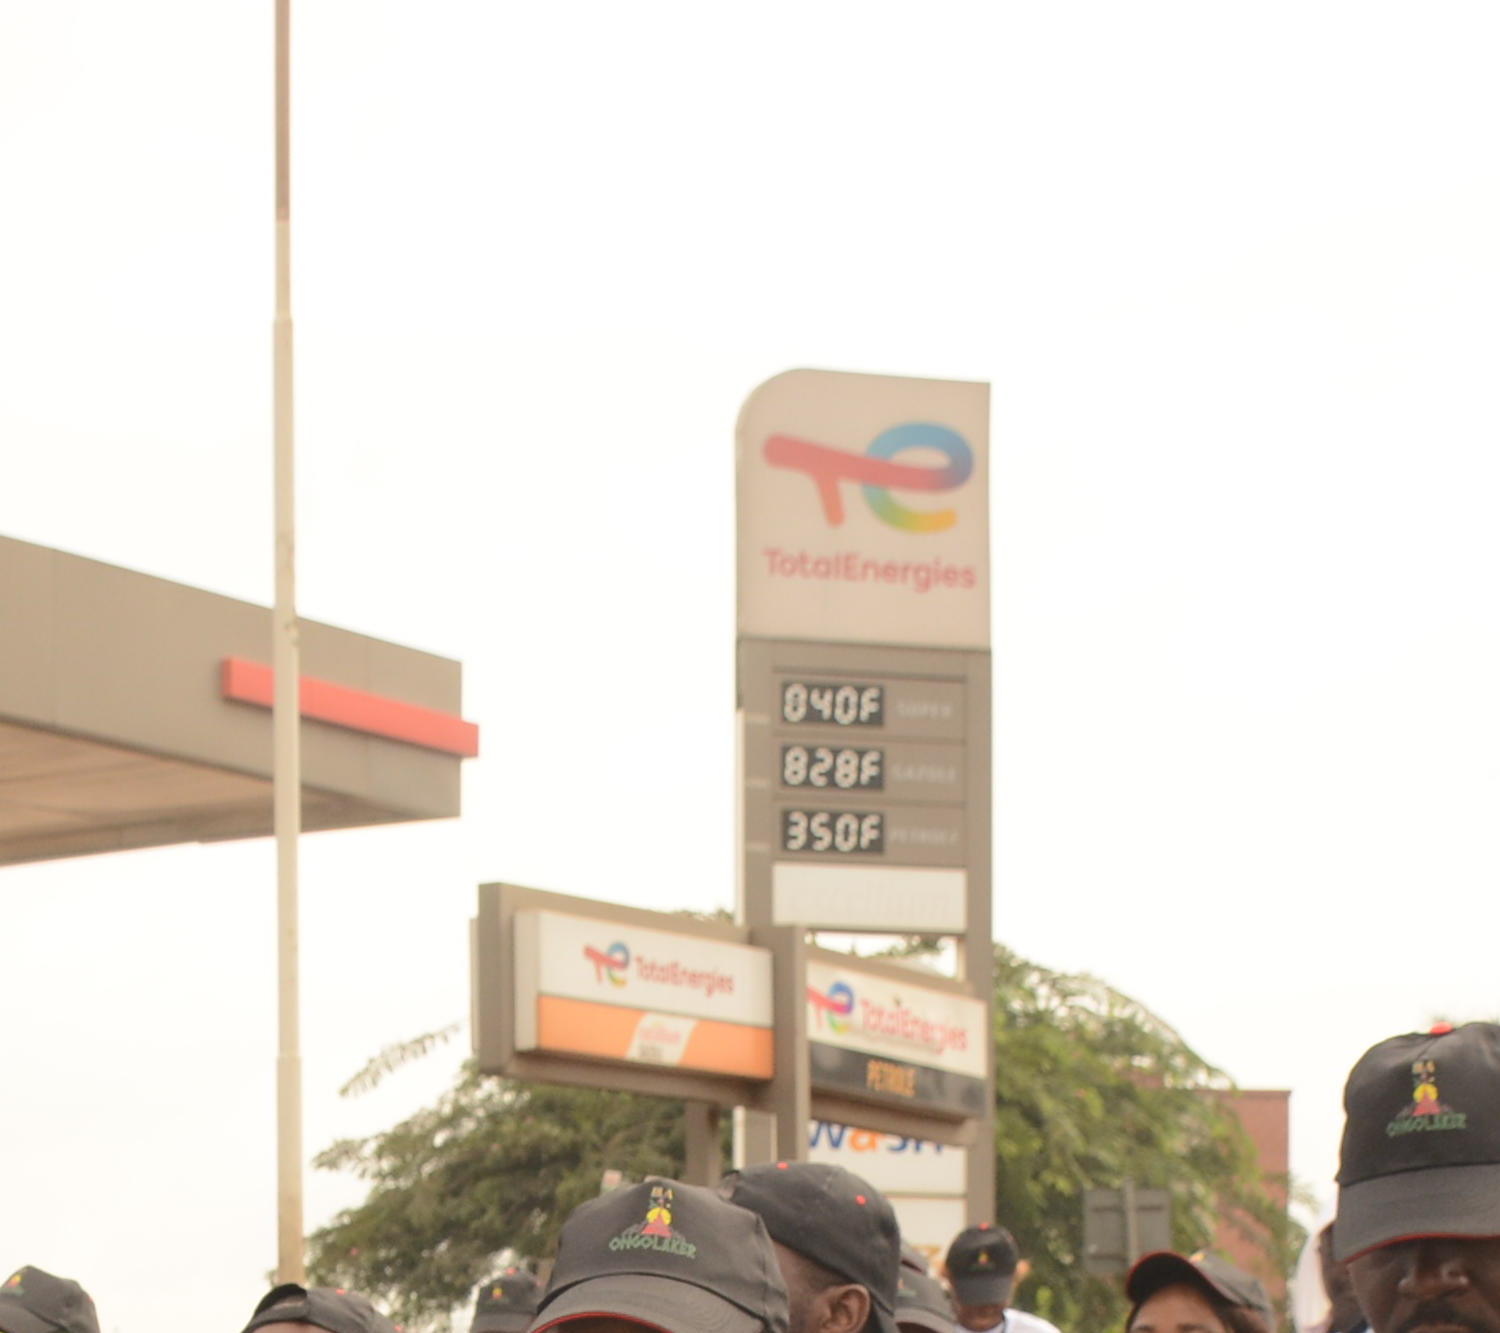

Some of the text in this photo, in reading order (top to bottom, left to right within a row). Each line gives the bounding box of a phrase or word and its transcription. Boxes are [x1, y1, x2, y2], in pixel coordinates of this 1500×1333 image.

[762, 548, 977, 593] TotalEnergies
[784, 746, 881, 788] 828F
[787, 810, 881, 852] 350F
[635, 955, 735, 996] TotalEnergies
[861, 1000, 968, 1055] TotalEnergies
